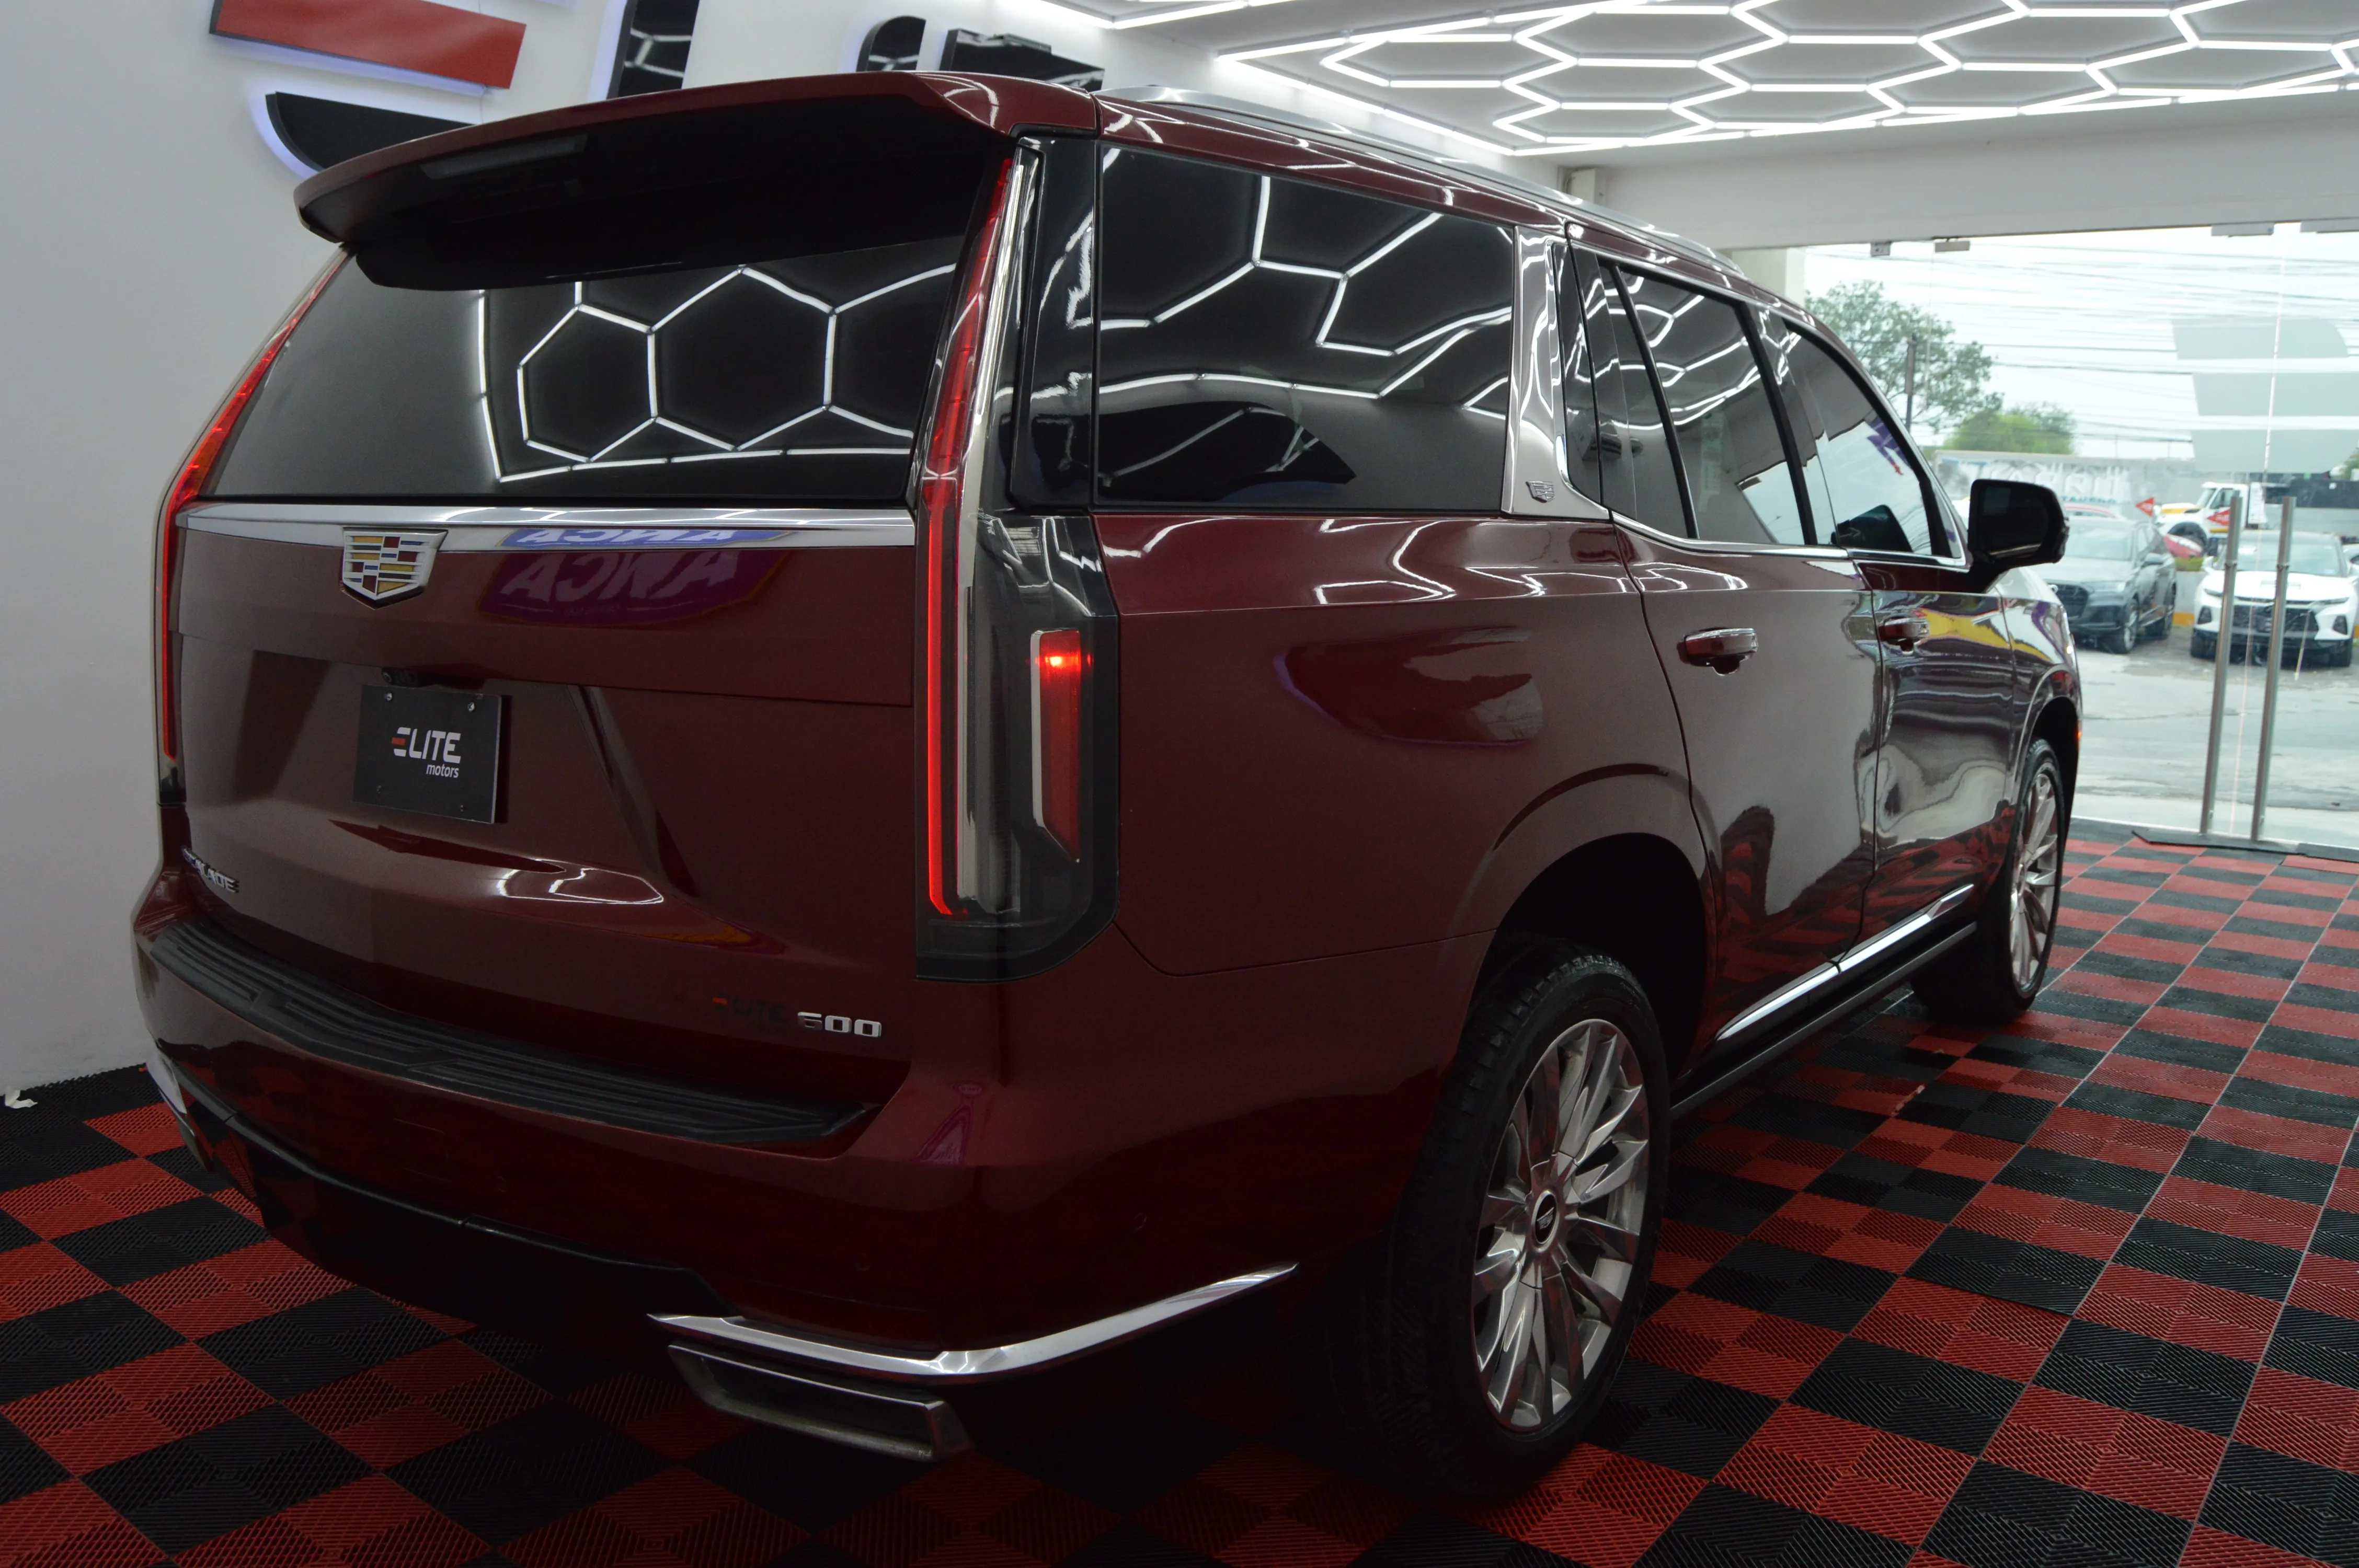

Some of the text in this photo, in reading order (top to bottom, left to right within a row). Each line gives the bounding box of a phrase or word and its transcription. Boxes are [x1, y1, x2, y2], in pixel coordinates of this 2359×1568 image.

[391, 727, 461, 763] ELITE
[426, 764, 459, 778] motors
[797, 1012, 882, 1037] 600
